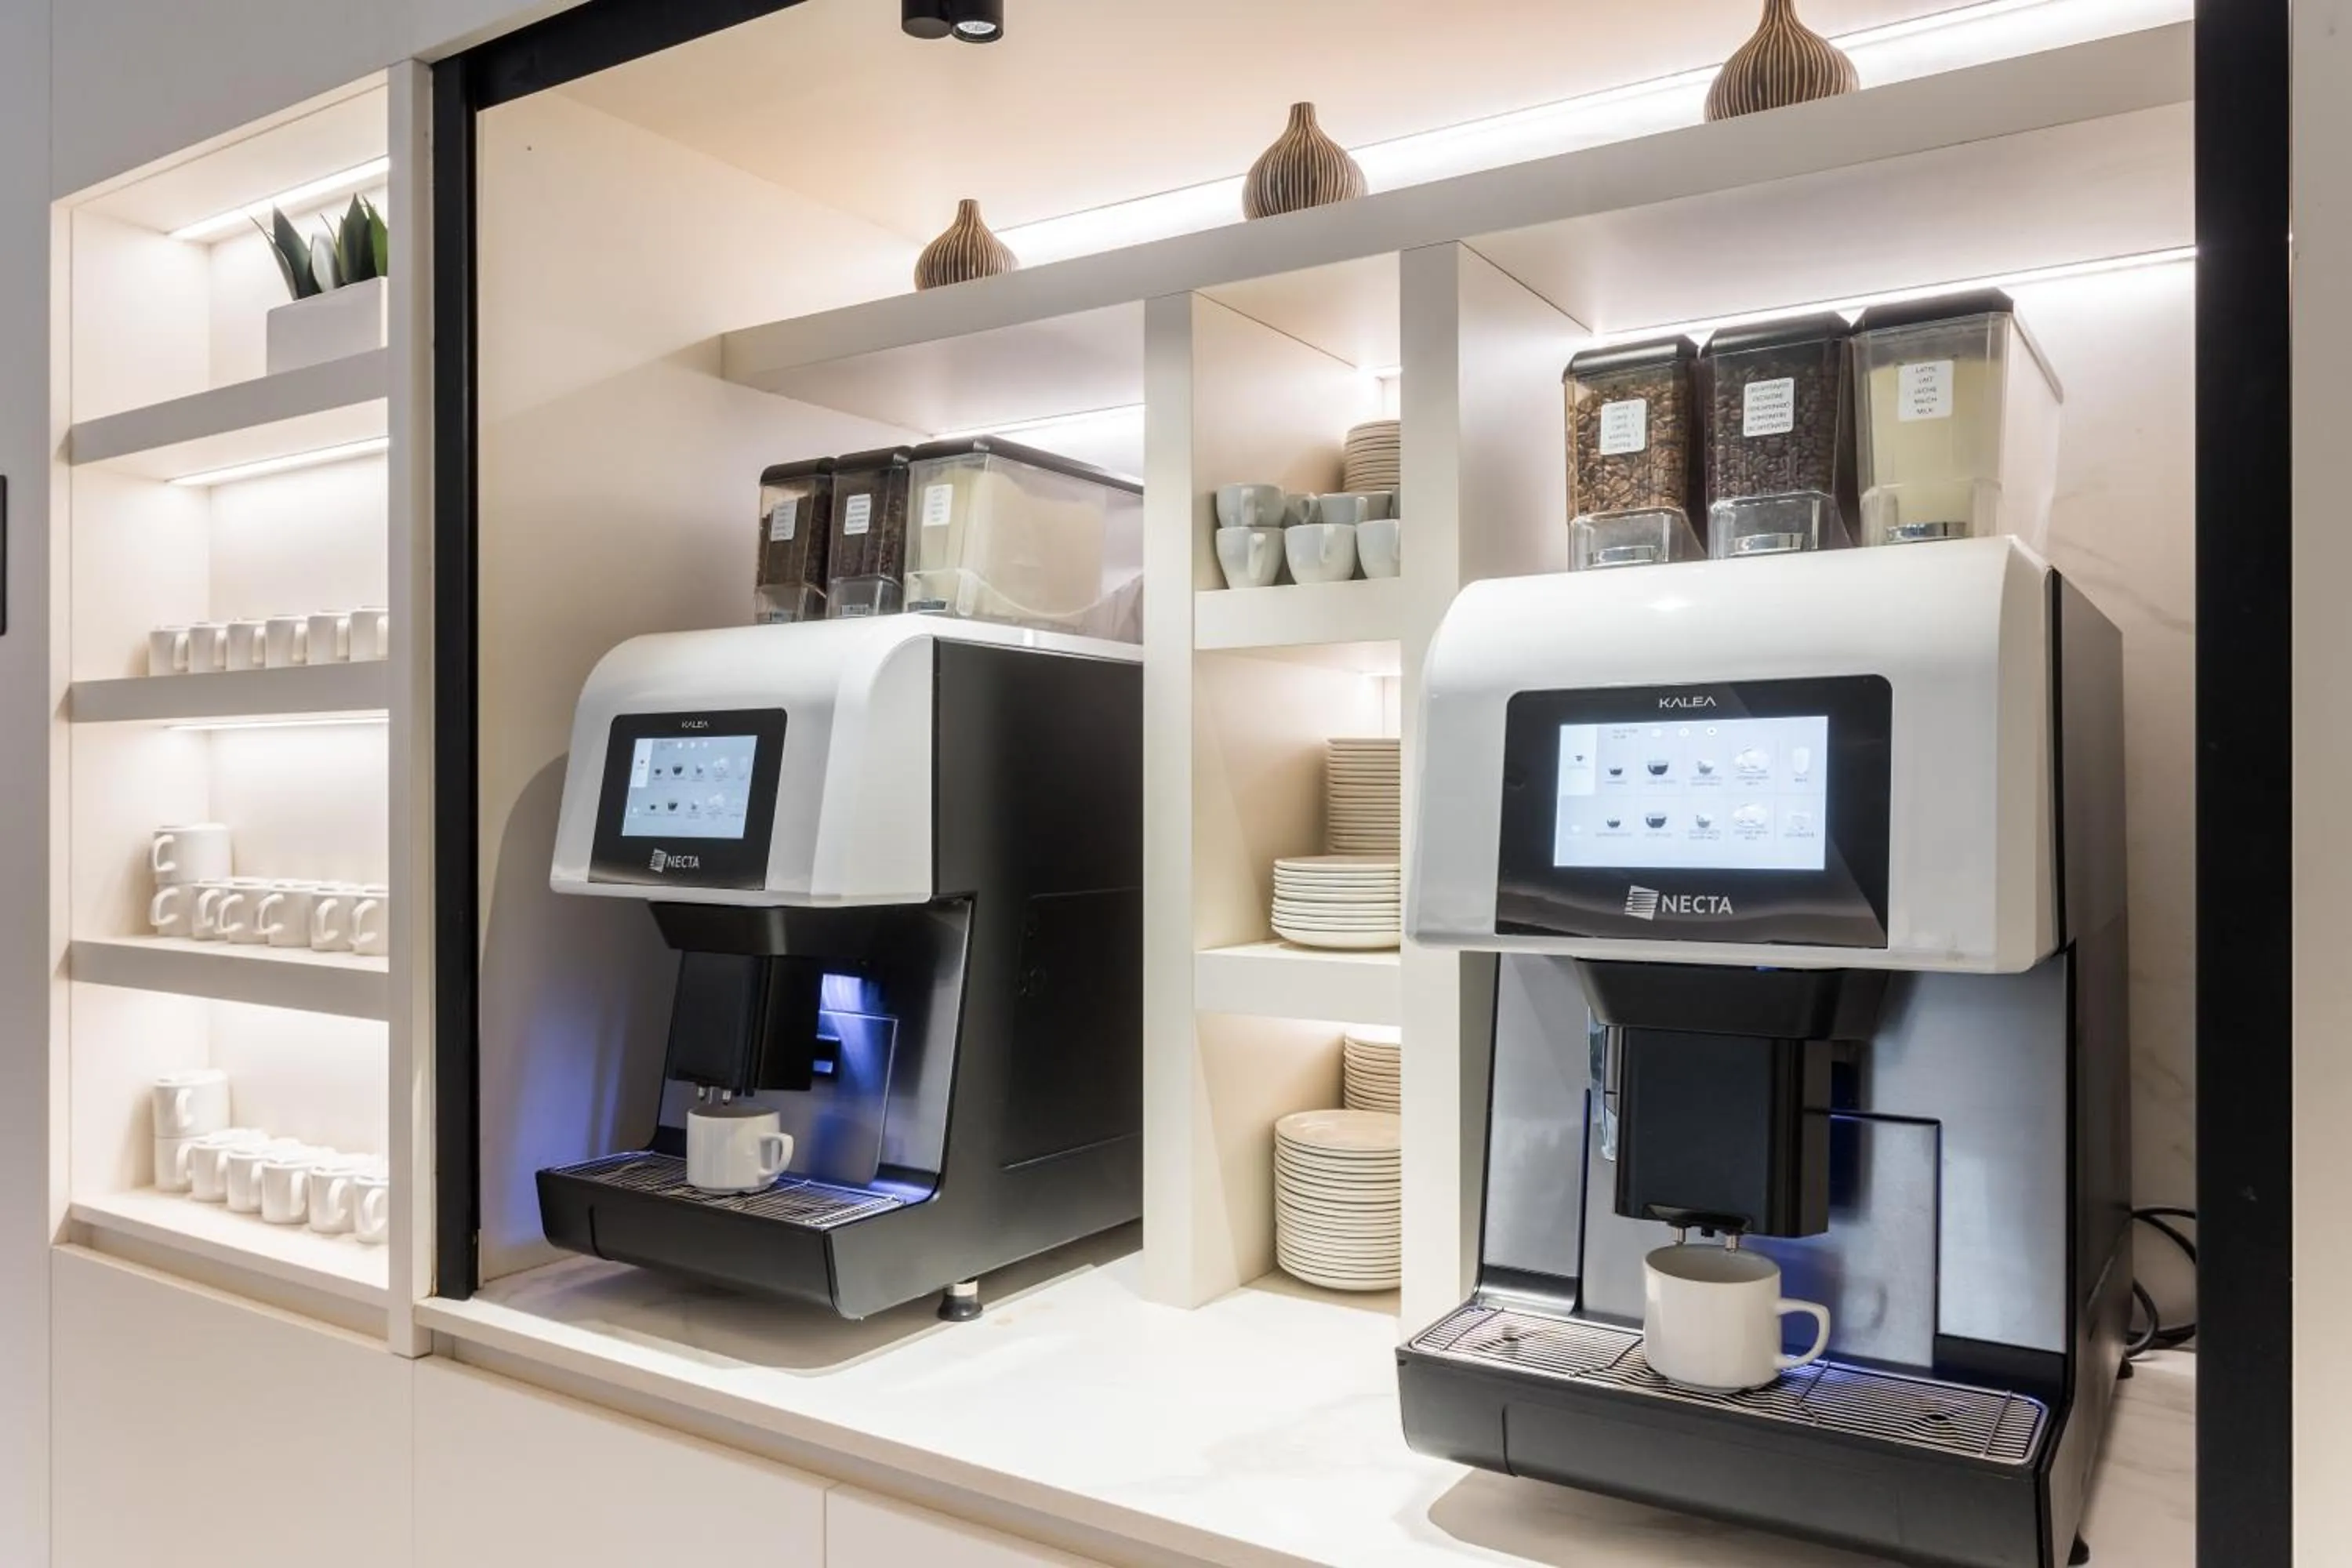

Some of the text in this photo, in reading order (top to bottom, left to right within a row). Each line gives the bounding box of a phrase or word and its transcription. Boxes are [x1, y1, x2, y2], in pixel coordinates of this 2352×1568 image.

[1659, 695, 1716, 709] KALEA
[666, 855, 700, 869] NECTA
[1661, 895, 1733, 916] NECTA
